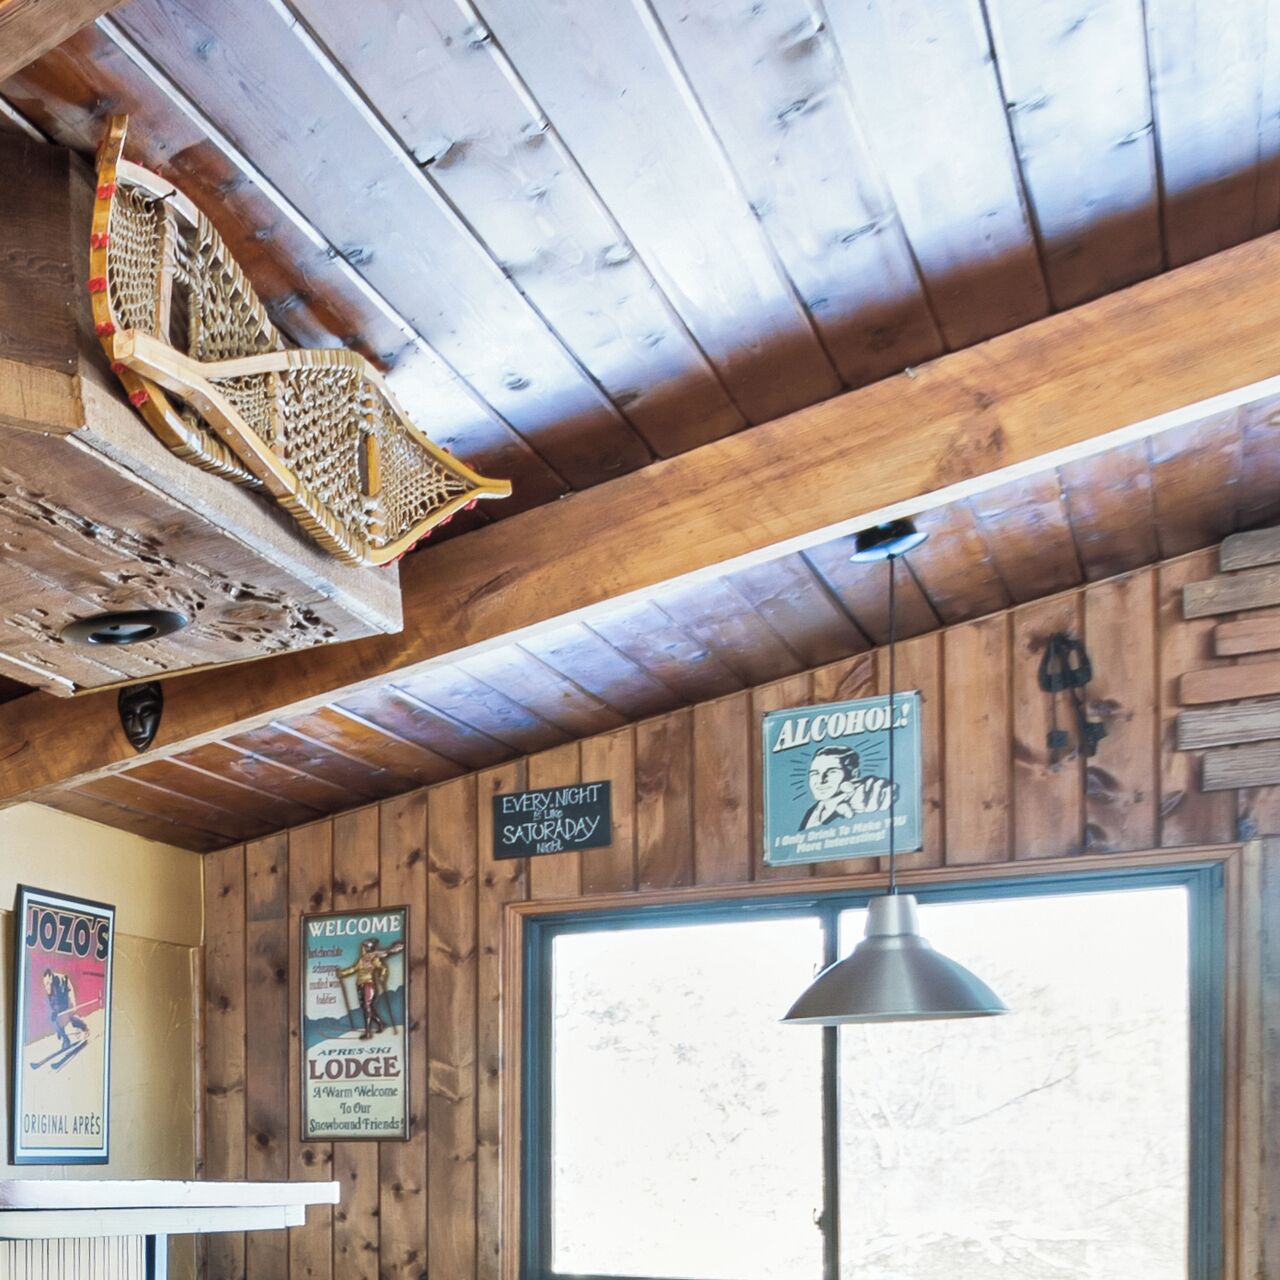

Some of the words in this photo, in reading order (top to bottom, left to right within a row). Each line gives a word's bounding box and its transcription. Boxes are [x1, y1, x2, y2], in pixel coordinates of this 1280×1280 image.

[772, 703, 912, 753] ALCOHOL!
[781, 833, 806, 846] Only
[807, 827, 837, 841] Drink
[838, 825, 850, 836] To
[852, 820, 882, 833] Make
[796, 841, 823, 853] More
[26, 908, 109, 961] JOZO'S
[308, 915, 401, 937] WELCOME
[317, 1046, 392, 1057] APRES-SKI
[309, 1055, 401, 1080] LODGE
[313, 1087, 322, 1099] A
[322, 1086, 353, 1098] Warm
[354, 1084, 399, 1098] Welcome
[340, 1102, 352, 1114] To
[353, 1102, 371, 1114] Our
[23, 1113, 69, 1135] ORIGINAL
[72, 1111, 101, 1135] APRÈS
[309, 1116, 361, 1133] Snowbound
